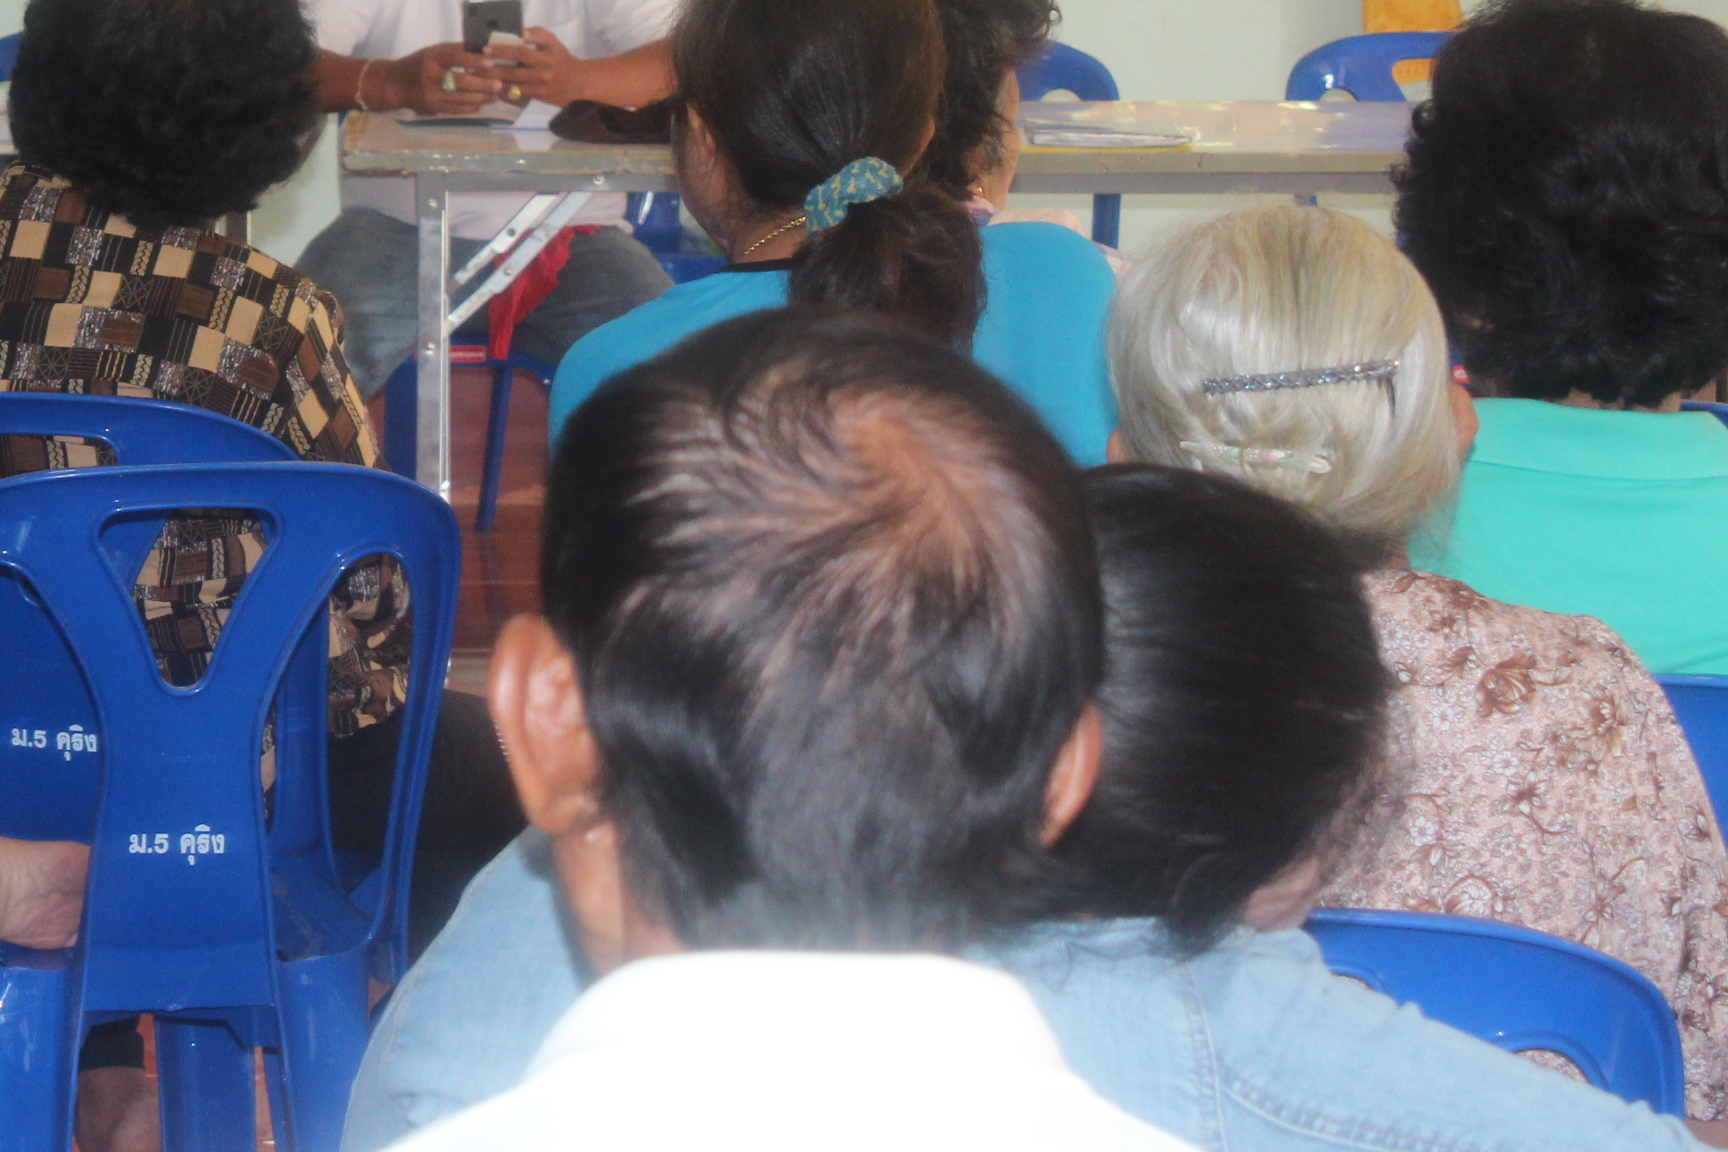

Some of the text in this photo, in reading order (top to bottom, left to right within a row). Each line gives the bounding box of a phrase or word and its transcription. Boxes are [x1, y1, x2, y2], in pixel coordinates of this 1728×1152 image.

[10, 724, 99, 762] ม.5 คุริง
[128, 823, 225, 865] ม.5 คุริง
